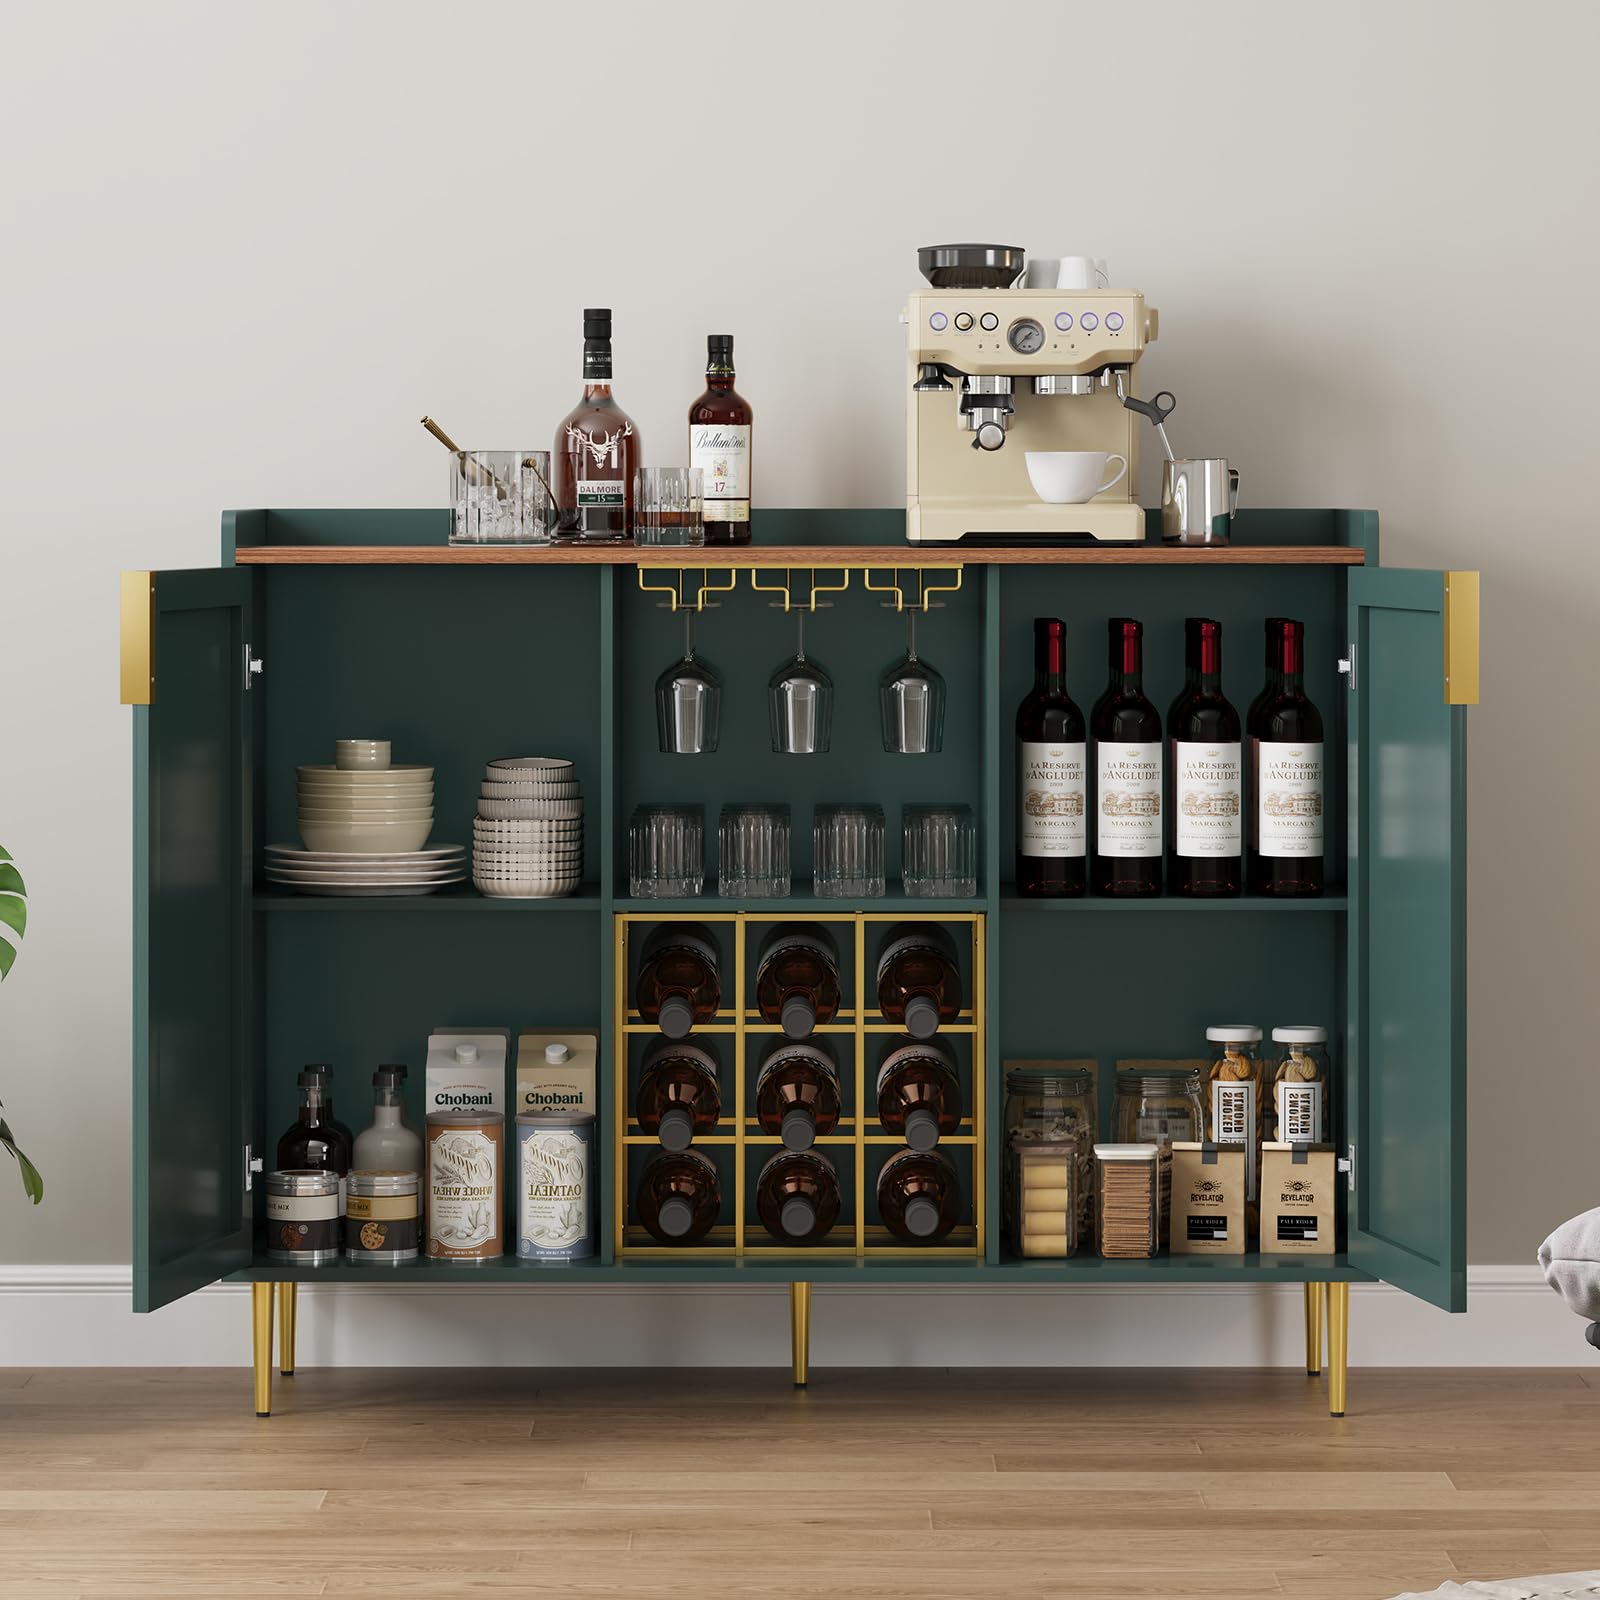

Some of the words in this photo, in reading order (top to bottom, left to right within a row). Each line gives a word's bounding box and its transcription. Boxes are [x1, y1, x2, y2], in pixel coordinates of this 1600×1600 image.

[715, 482, 725, 492] 17
[435, 1092, 493, 1105] Chobani
[525, 1092, 583, 1104] Chobani
[1190, 1193, 1224, 1202] REVELATOR
[1280, 1193, 1314, 1202] REVELATOR
